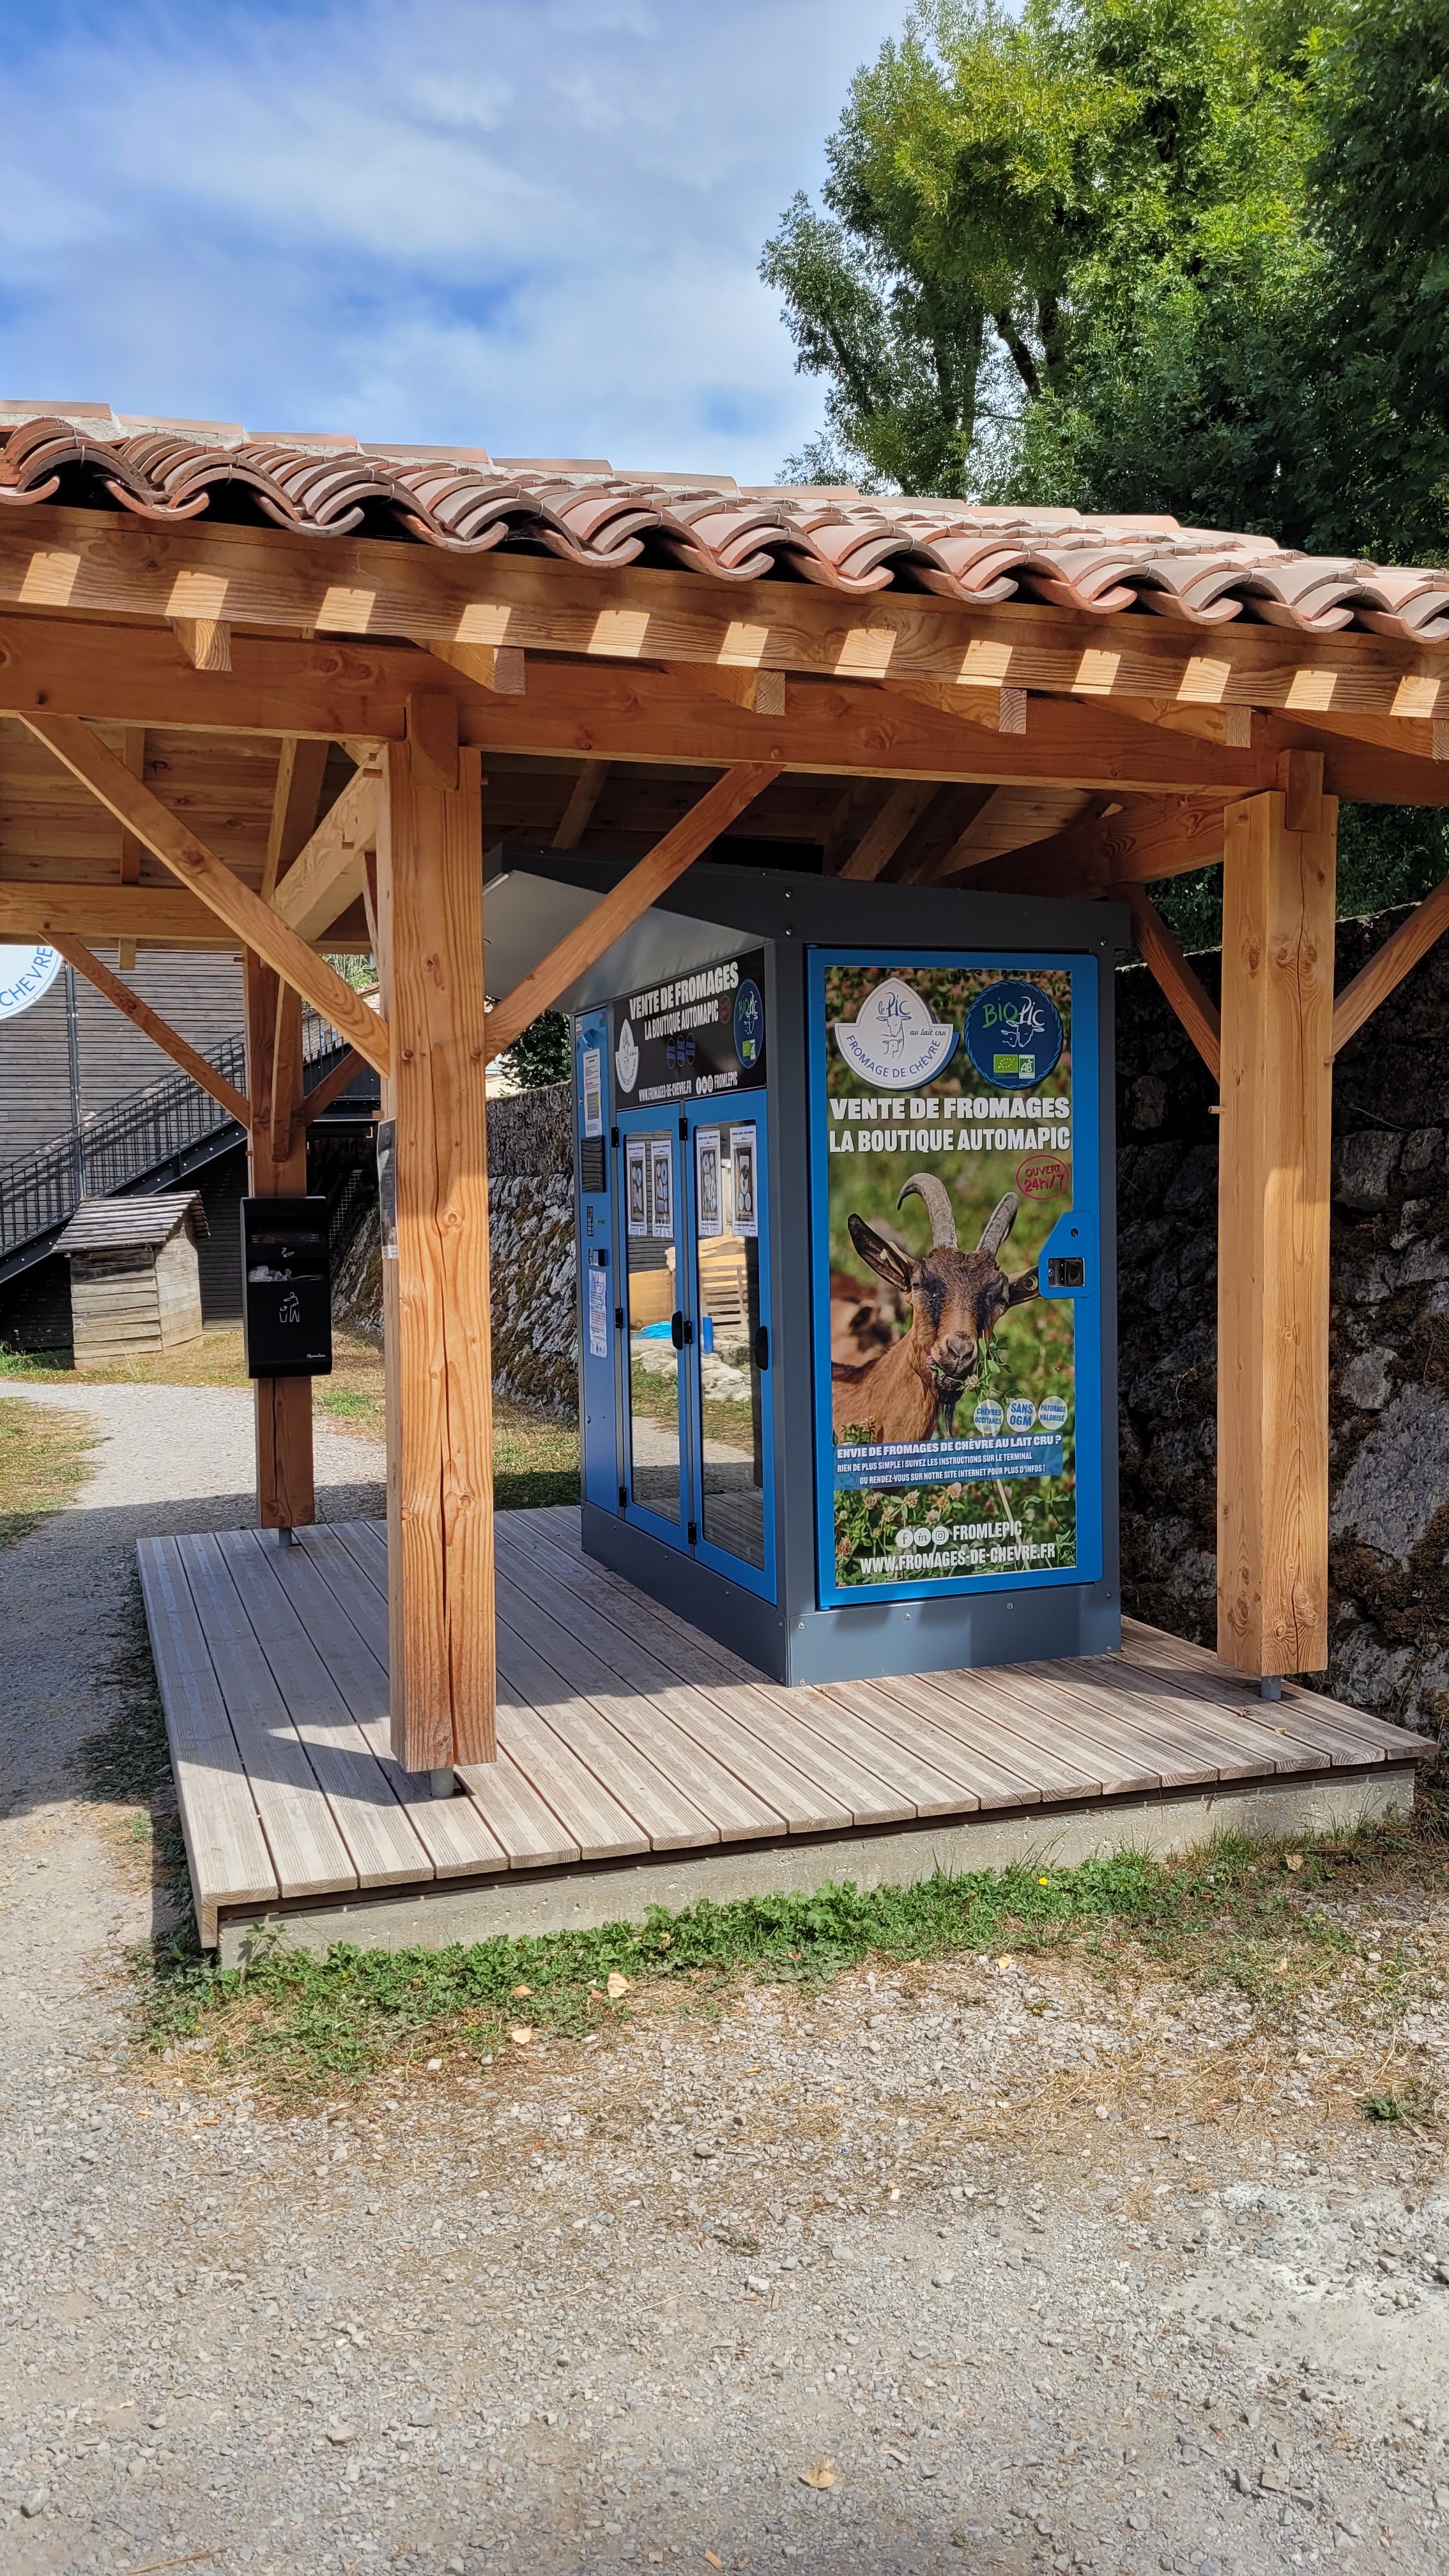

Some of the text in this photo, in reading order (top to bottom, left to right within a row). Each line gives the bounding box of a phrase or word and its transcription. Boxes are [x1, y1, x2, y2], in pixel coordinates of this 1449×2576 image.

[629, 990, 659, 1020] VENTE
[661, 985, 674, 1011] DE
[675, 962, 739, 1006] FROMAGES
[645, 1020, 652, 1041] LA
[652, 1011, 681, 1039] BOUTIQUE
[681, 999, 719, 1031] AUTOMAPIC
[846, 1034, 941, 1078] FROMAGE DE CHÈVRE
[1020, 1062, 1032, 1073] AB
[714, 1071, 738, 1089] FROMLEPIC
[829, 1097, 1070, 1120] VENTE DE FROMAGES
[830, 1126, 1071, 1153] LA BOUTIQUE AUTOMAPIC
[1025, 1163, 1061, 1177] OUVERT
[1011, 1402, 1033, 1414] SANS
[975, 1416, 1001, 1425] OCCITANES
[1009, 1415, 1032, 1427] OGM
[837, 1435, 1062, 1459] ENVIE DE FROMAGES DE CHÈVRE AU LAIT CRU ?
[837, 1463, 852, 1473] RIEN
[852, 1463, 861, 1471] DE
[862, 1461, 877, 1471] PLUS
[878, 1460, 901, 1470] SIMPLE
[905, 1459, 926, 1468] SUIVEZ
[927, 1458, 938, 1467] LES
[939, 1455, 981, 1466] INSTRUCTIONS
[983, 1454, 995, 1463] SUR
[995, 1453, 1003, 1462] LE
[1003, 1452, 1033, 1461] TERMINAL
[860, 1476, 868, 1485] OU
[869, 1474, 910, 1484] RENDEZ-VOUS
[910, 1473, 923, 1481] SUR
[923, 1471, 943, 1480] NOTRE
[944, 1470, 958, 1479] SITE
[958, 1468, 986, 1478] INTERNET
[987, 1467, 1003, 1476] POUR
[1004, 1466, 1019, 1475] PLUS
[1020, 1464, 1043, 1474] D'INFOS
[953, 1521, 1022, 1541] FROMLEPIC
[860, 1543, 1055, 1574] WWW.FROMAGES-DE-CHEVRE.FR
